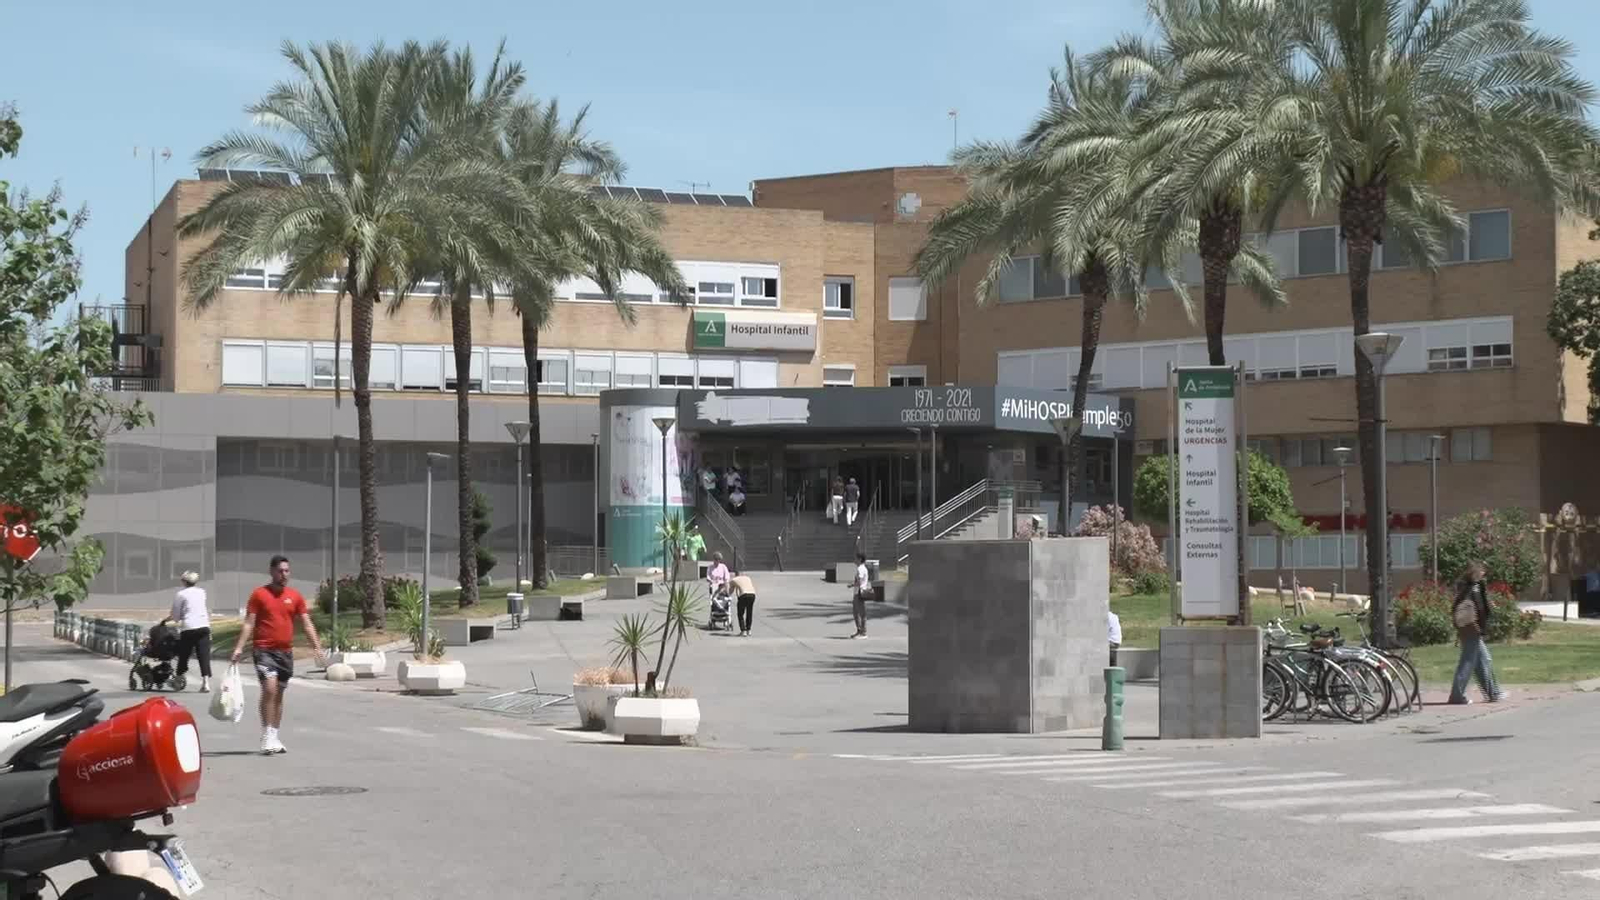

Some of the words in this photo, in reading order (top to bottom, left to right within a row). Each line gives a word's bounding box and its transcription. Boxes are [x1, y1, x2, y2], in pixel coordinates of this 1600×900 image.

[731, 324, 771, 336] Hospital
[773, 325, 809, 336] Infantil
[914, 388, 933, 408] 1971
[946, 388, 972, 408] 2021
[900, 408, 944, 422] CRECIENDO
[946, 407, 981, 422] CONTIGO
[1185, 418, 1216, 427] Hospital
[1204, 427, 1226, 435] Mujer
[1184, 437, 1228, 445] URGENCIAS
[1186, 469, 1217, 478] Hospital
[88, 755, 133, 773] acciona
